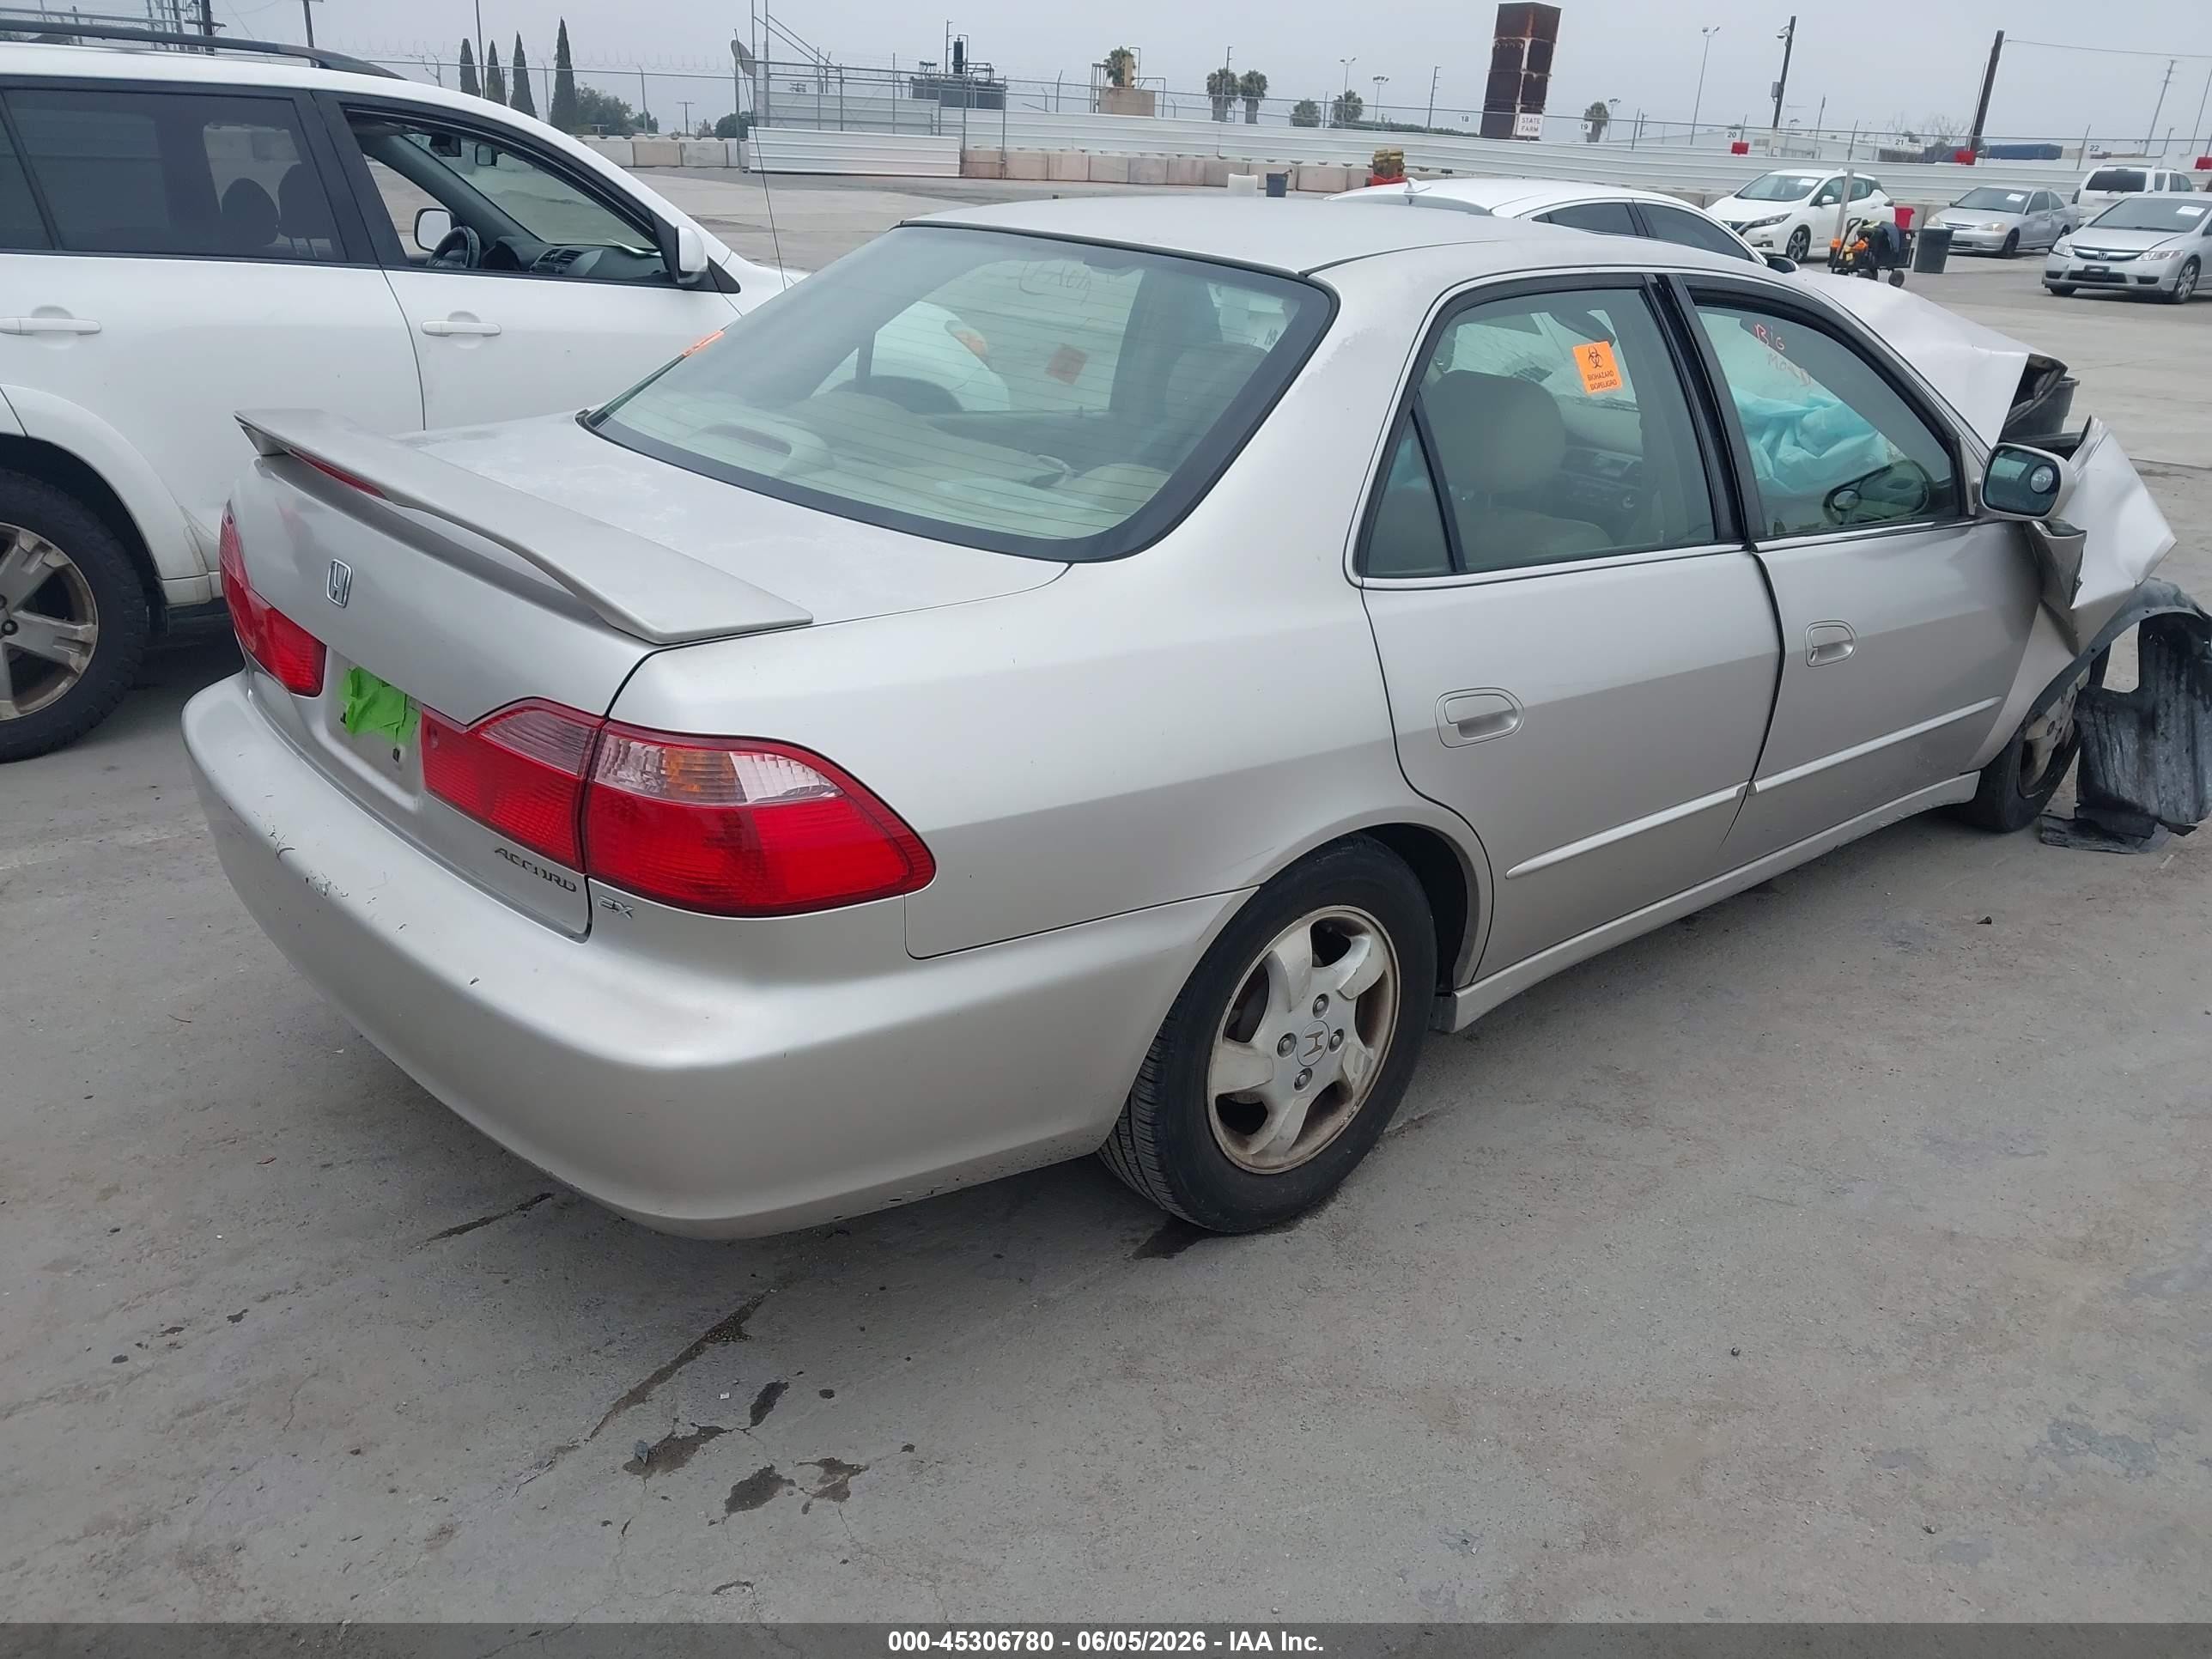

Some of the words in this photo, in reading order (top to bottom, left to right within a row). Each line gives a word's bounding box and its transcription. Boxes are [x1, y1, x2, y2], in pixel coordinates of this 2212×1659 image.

[1587, 370, 1614, 381] BIOHAZARD
[1589, 379, 1618, 391] BIOPELIGRO
[494, 847, 577, 893] ACCORD
[597, 895, 635, 920] EX
